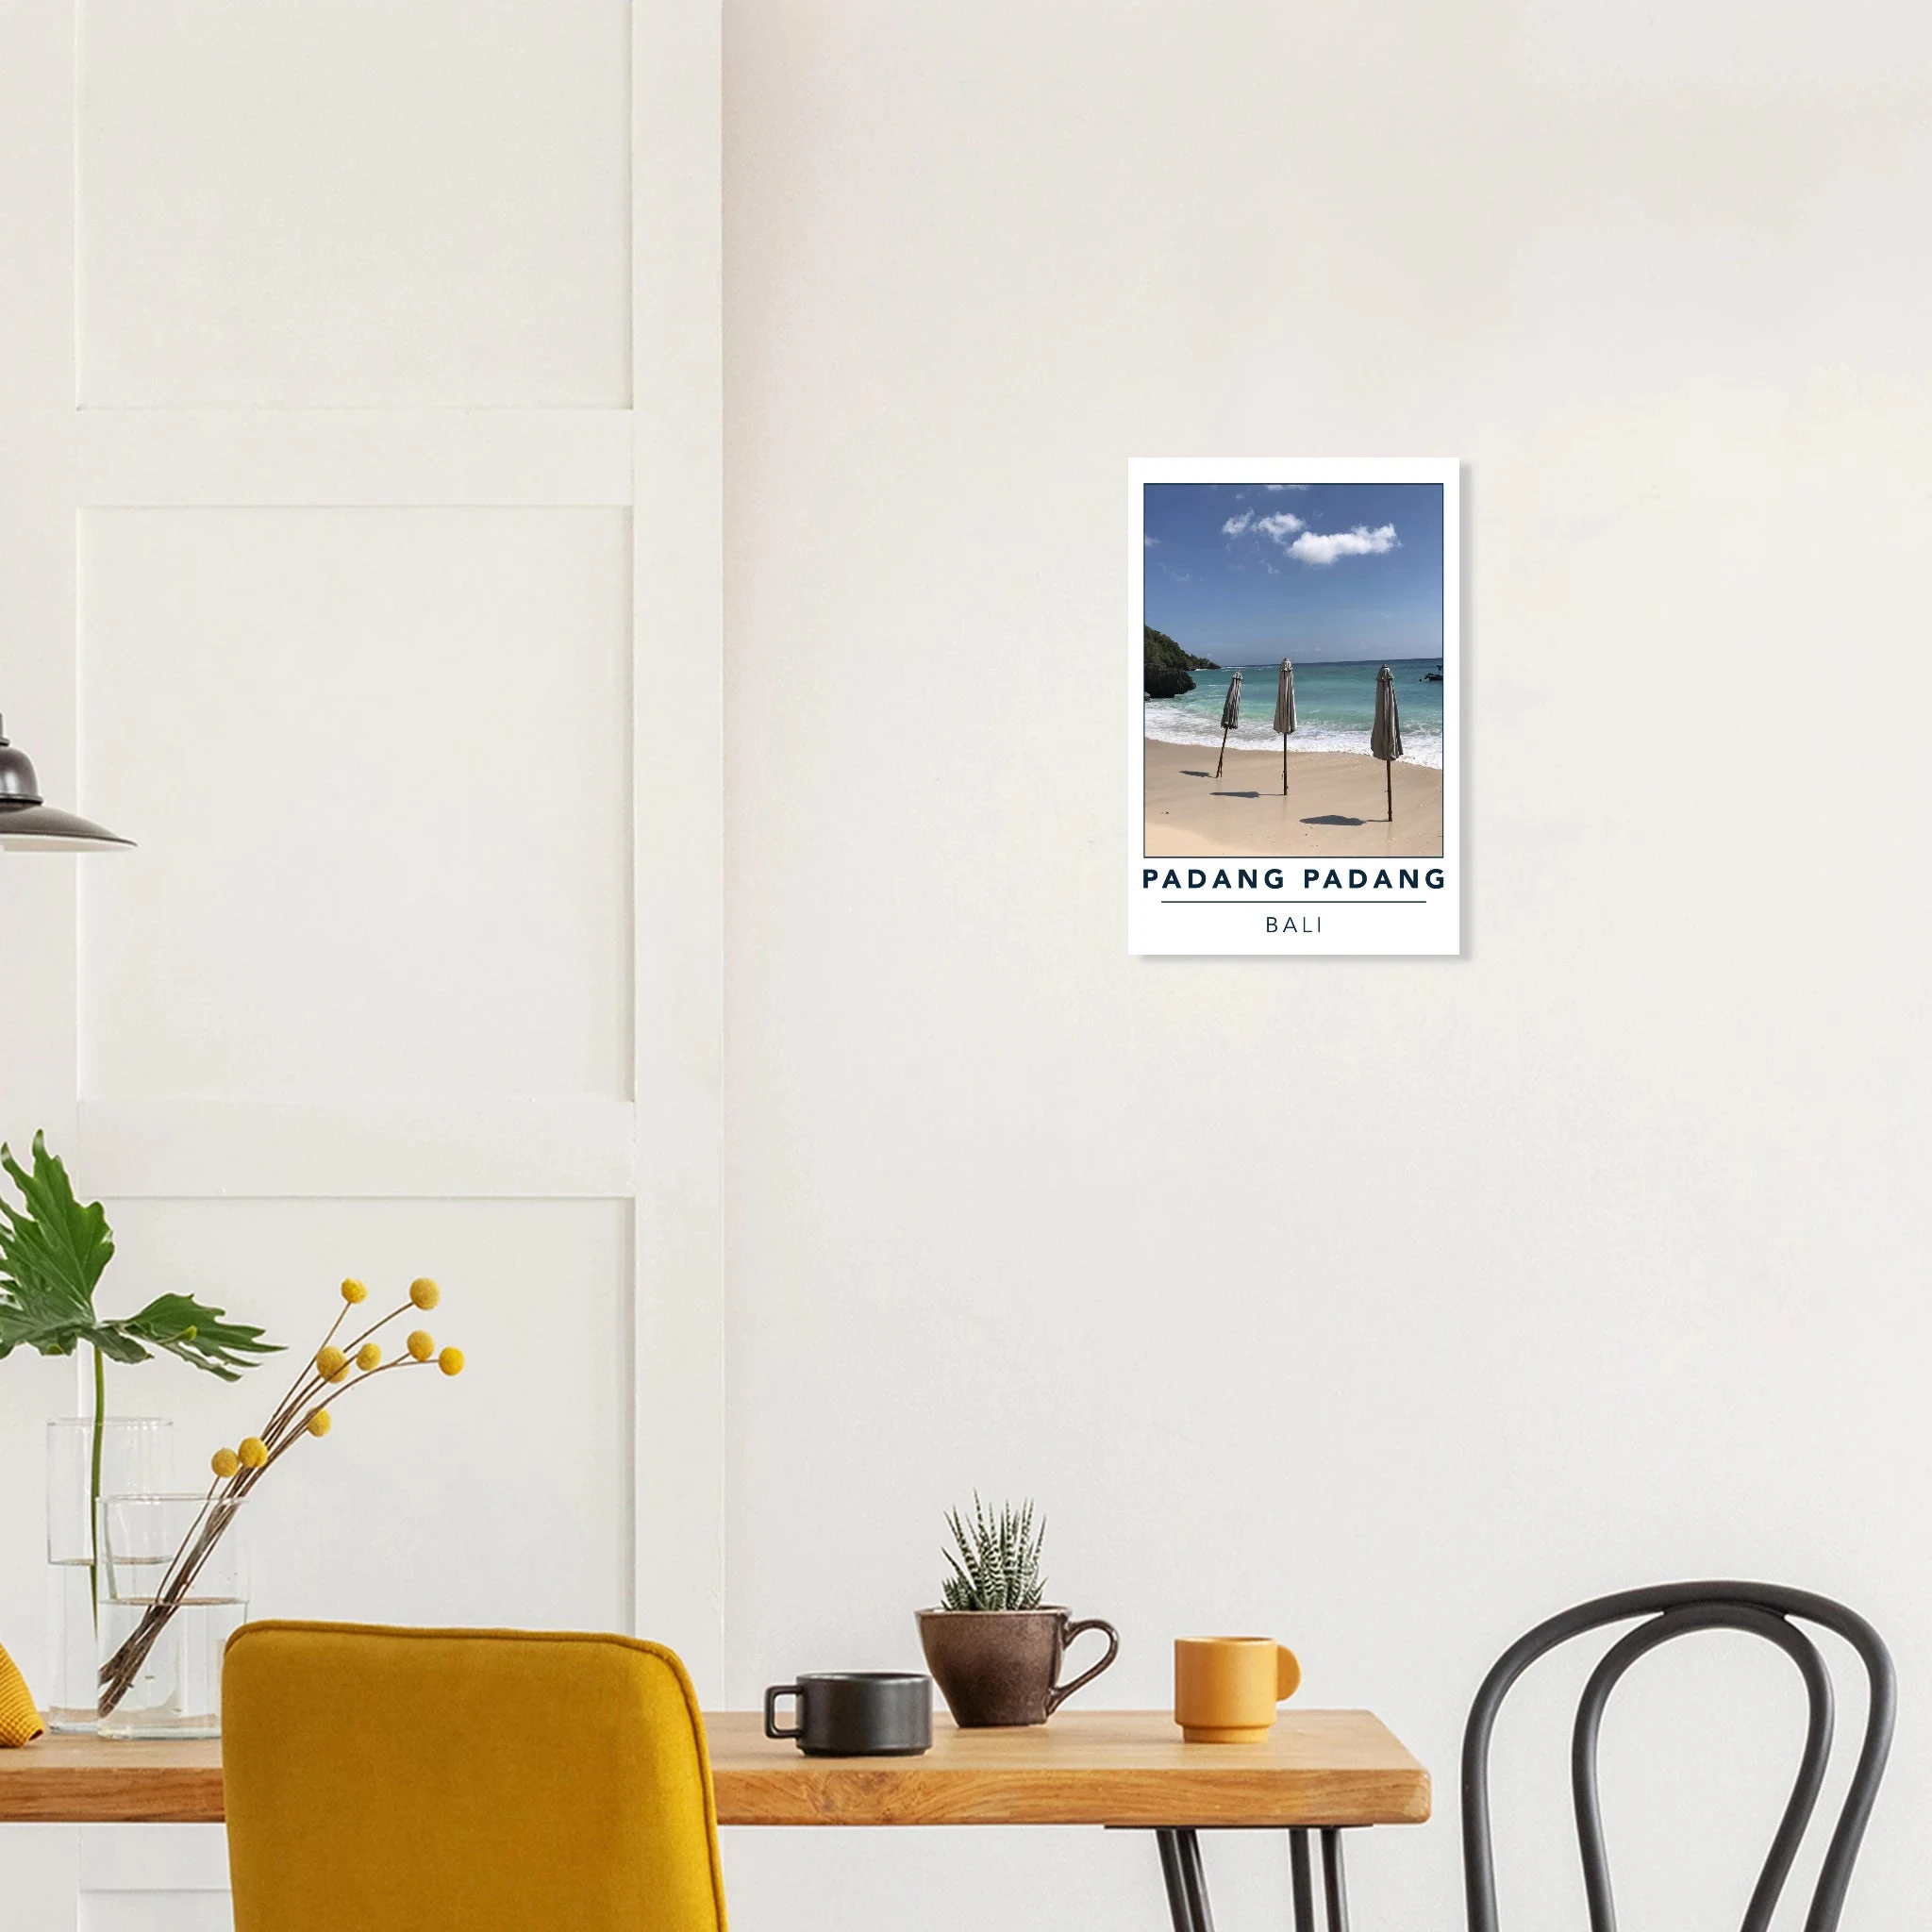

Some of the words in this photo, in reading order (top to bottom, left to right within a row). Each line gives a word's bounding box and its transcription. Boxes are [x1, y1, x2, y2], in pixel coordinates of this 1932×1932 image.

[1142, 868, 1284, 890] PADANG
[1304, 868, 1445, 890] PADANG
[1266, 916, 1322, 933] BALI
